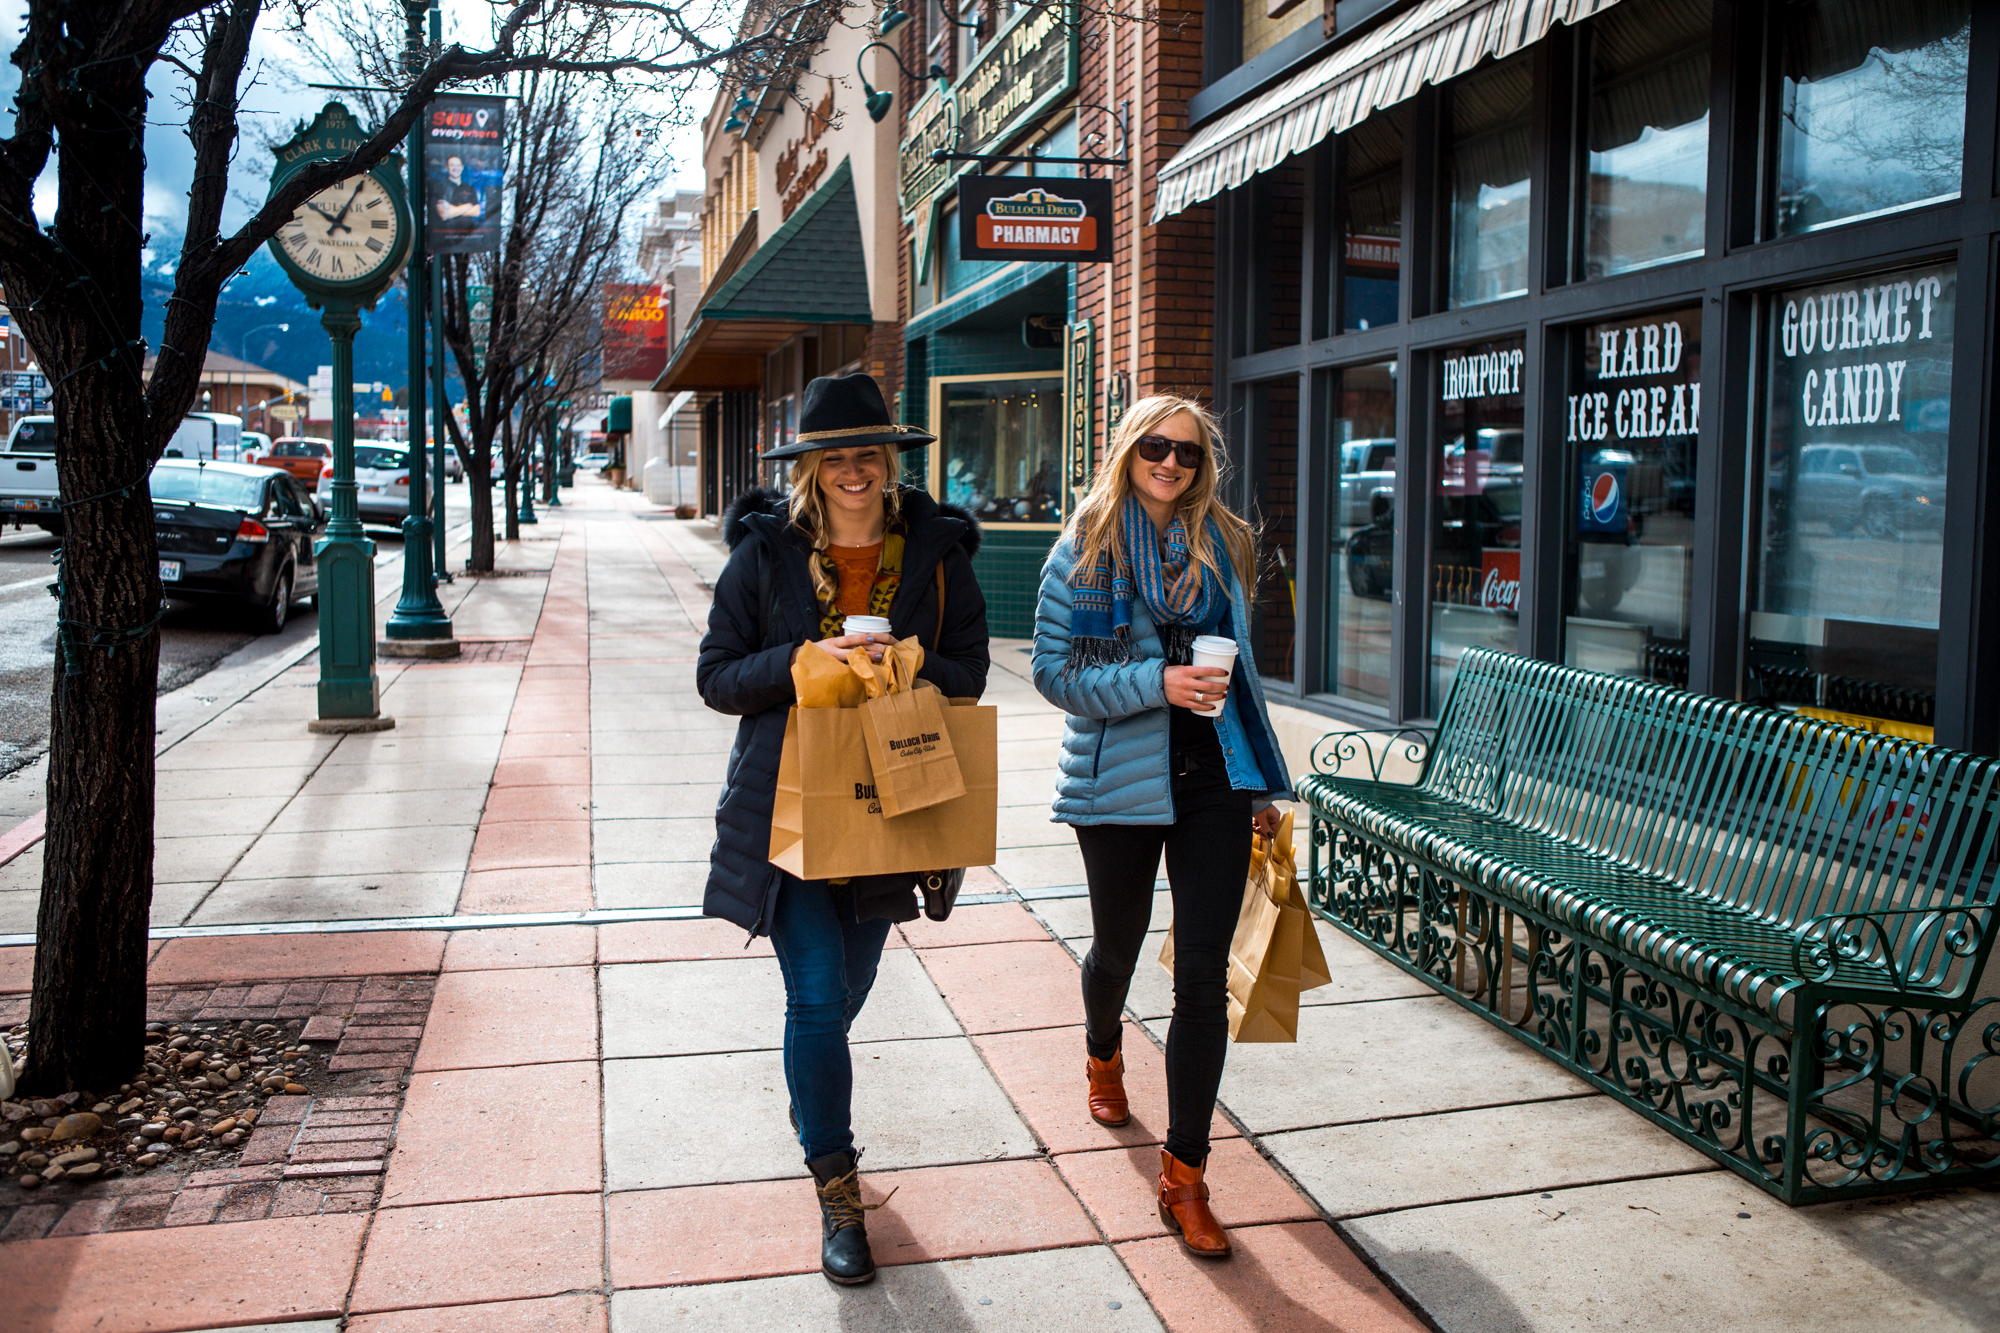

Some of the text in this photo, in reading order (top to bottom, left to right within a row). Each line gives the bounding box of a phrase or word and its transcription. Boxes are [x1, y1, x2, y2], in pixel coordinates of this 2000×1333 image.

[959, 60, 1002, 119] Trophies
[978, 70, 1034, 140] Engraving
[325, 120, 347, 129] 1975
[431, 128, 499, 140] everywhere
[432, 111, 473, 127] SUU
[284, 138, 321, 163] CLARK
[325, 137, 337, 150] &
[995, 202, 1078, 216] BULLOCH DRUG
[993, 225, 1081, 244] PHARMACY
[1782, 275, 1942, 357] GOURMET
[1443, 348, 1524, 401] IRONPORT
[1598, 321, 1683, 380] HARD
[1075, 342, 1086, 478] DIAMONDS
[1567, 389, 1609, 442] ICE
[1802, 360, 1907, 427] CANDY
[1583, 475, 1592, 520] pepsi
[889, 732, 941, 751] BULLOCH DRUG
